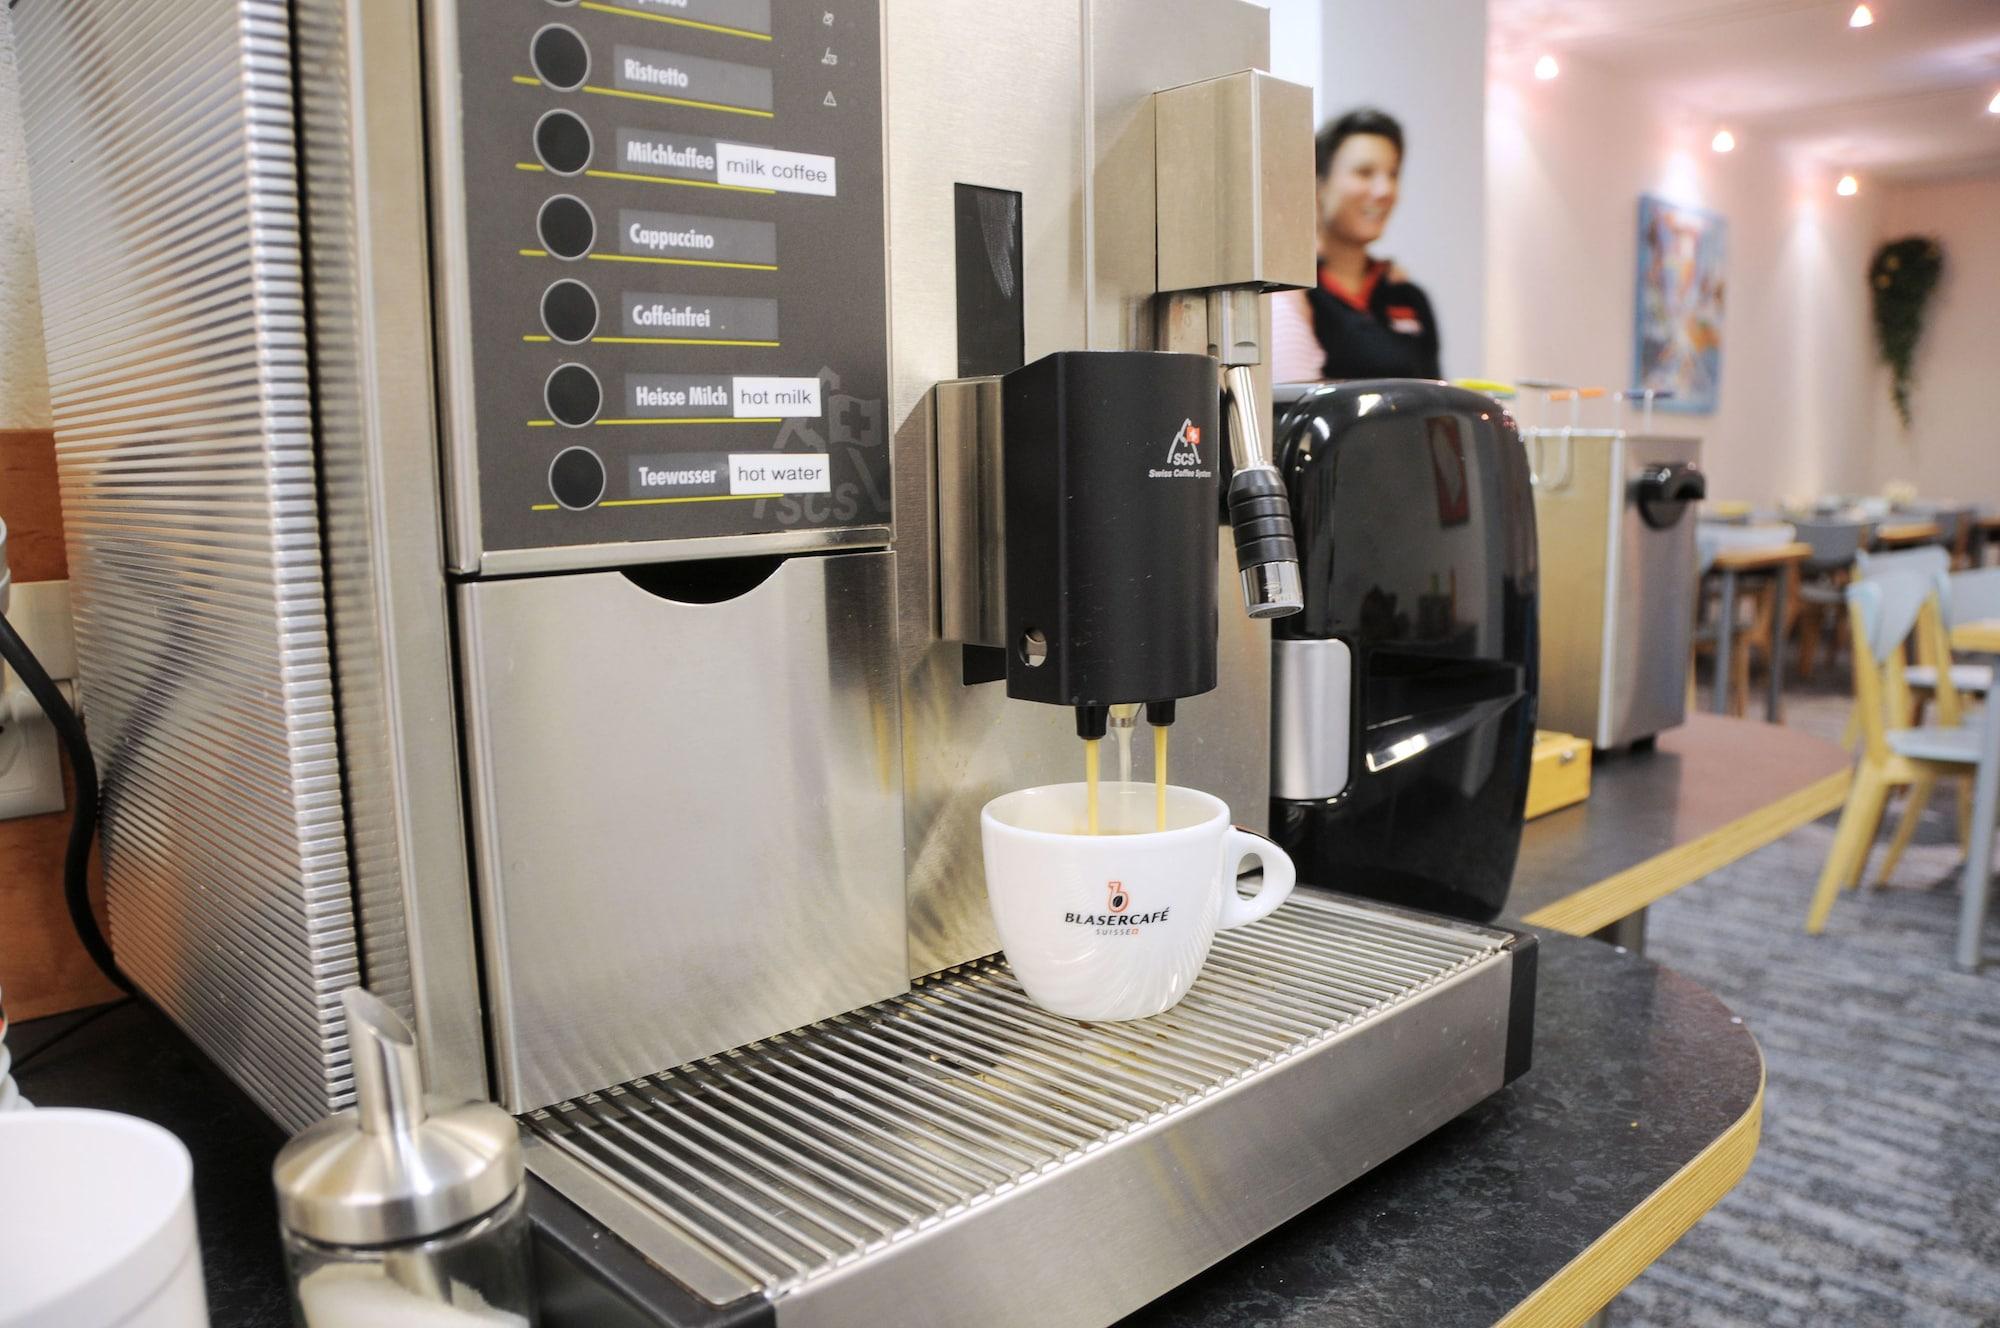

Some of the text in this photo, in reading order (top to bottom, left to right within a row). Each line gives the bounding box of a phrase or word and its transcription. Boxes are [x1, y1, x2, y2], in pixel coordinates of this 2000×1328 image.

[624, 58, 688, 87] Ristretto
[627, 141, 714, 170] Milchkaffee
[726, 159, 828, 183] milk coffee
[629, 222, 714, 250] Cappuccino
[632, 304, 711, 328] Coffeinfrei
[635, 385, 728, 406] Heisse Milch
[741, 389, 812, 405] hot milk
[1173, 453, 1195, 466] SCS
[638, 466, 717, 486] Teewasser
[738, 466, 822, 482] hot water
[1064, 906, 1170, 926] BLASERCAFÉ
[1096, 928, 1131, 937] SUISSE
